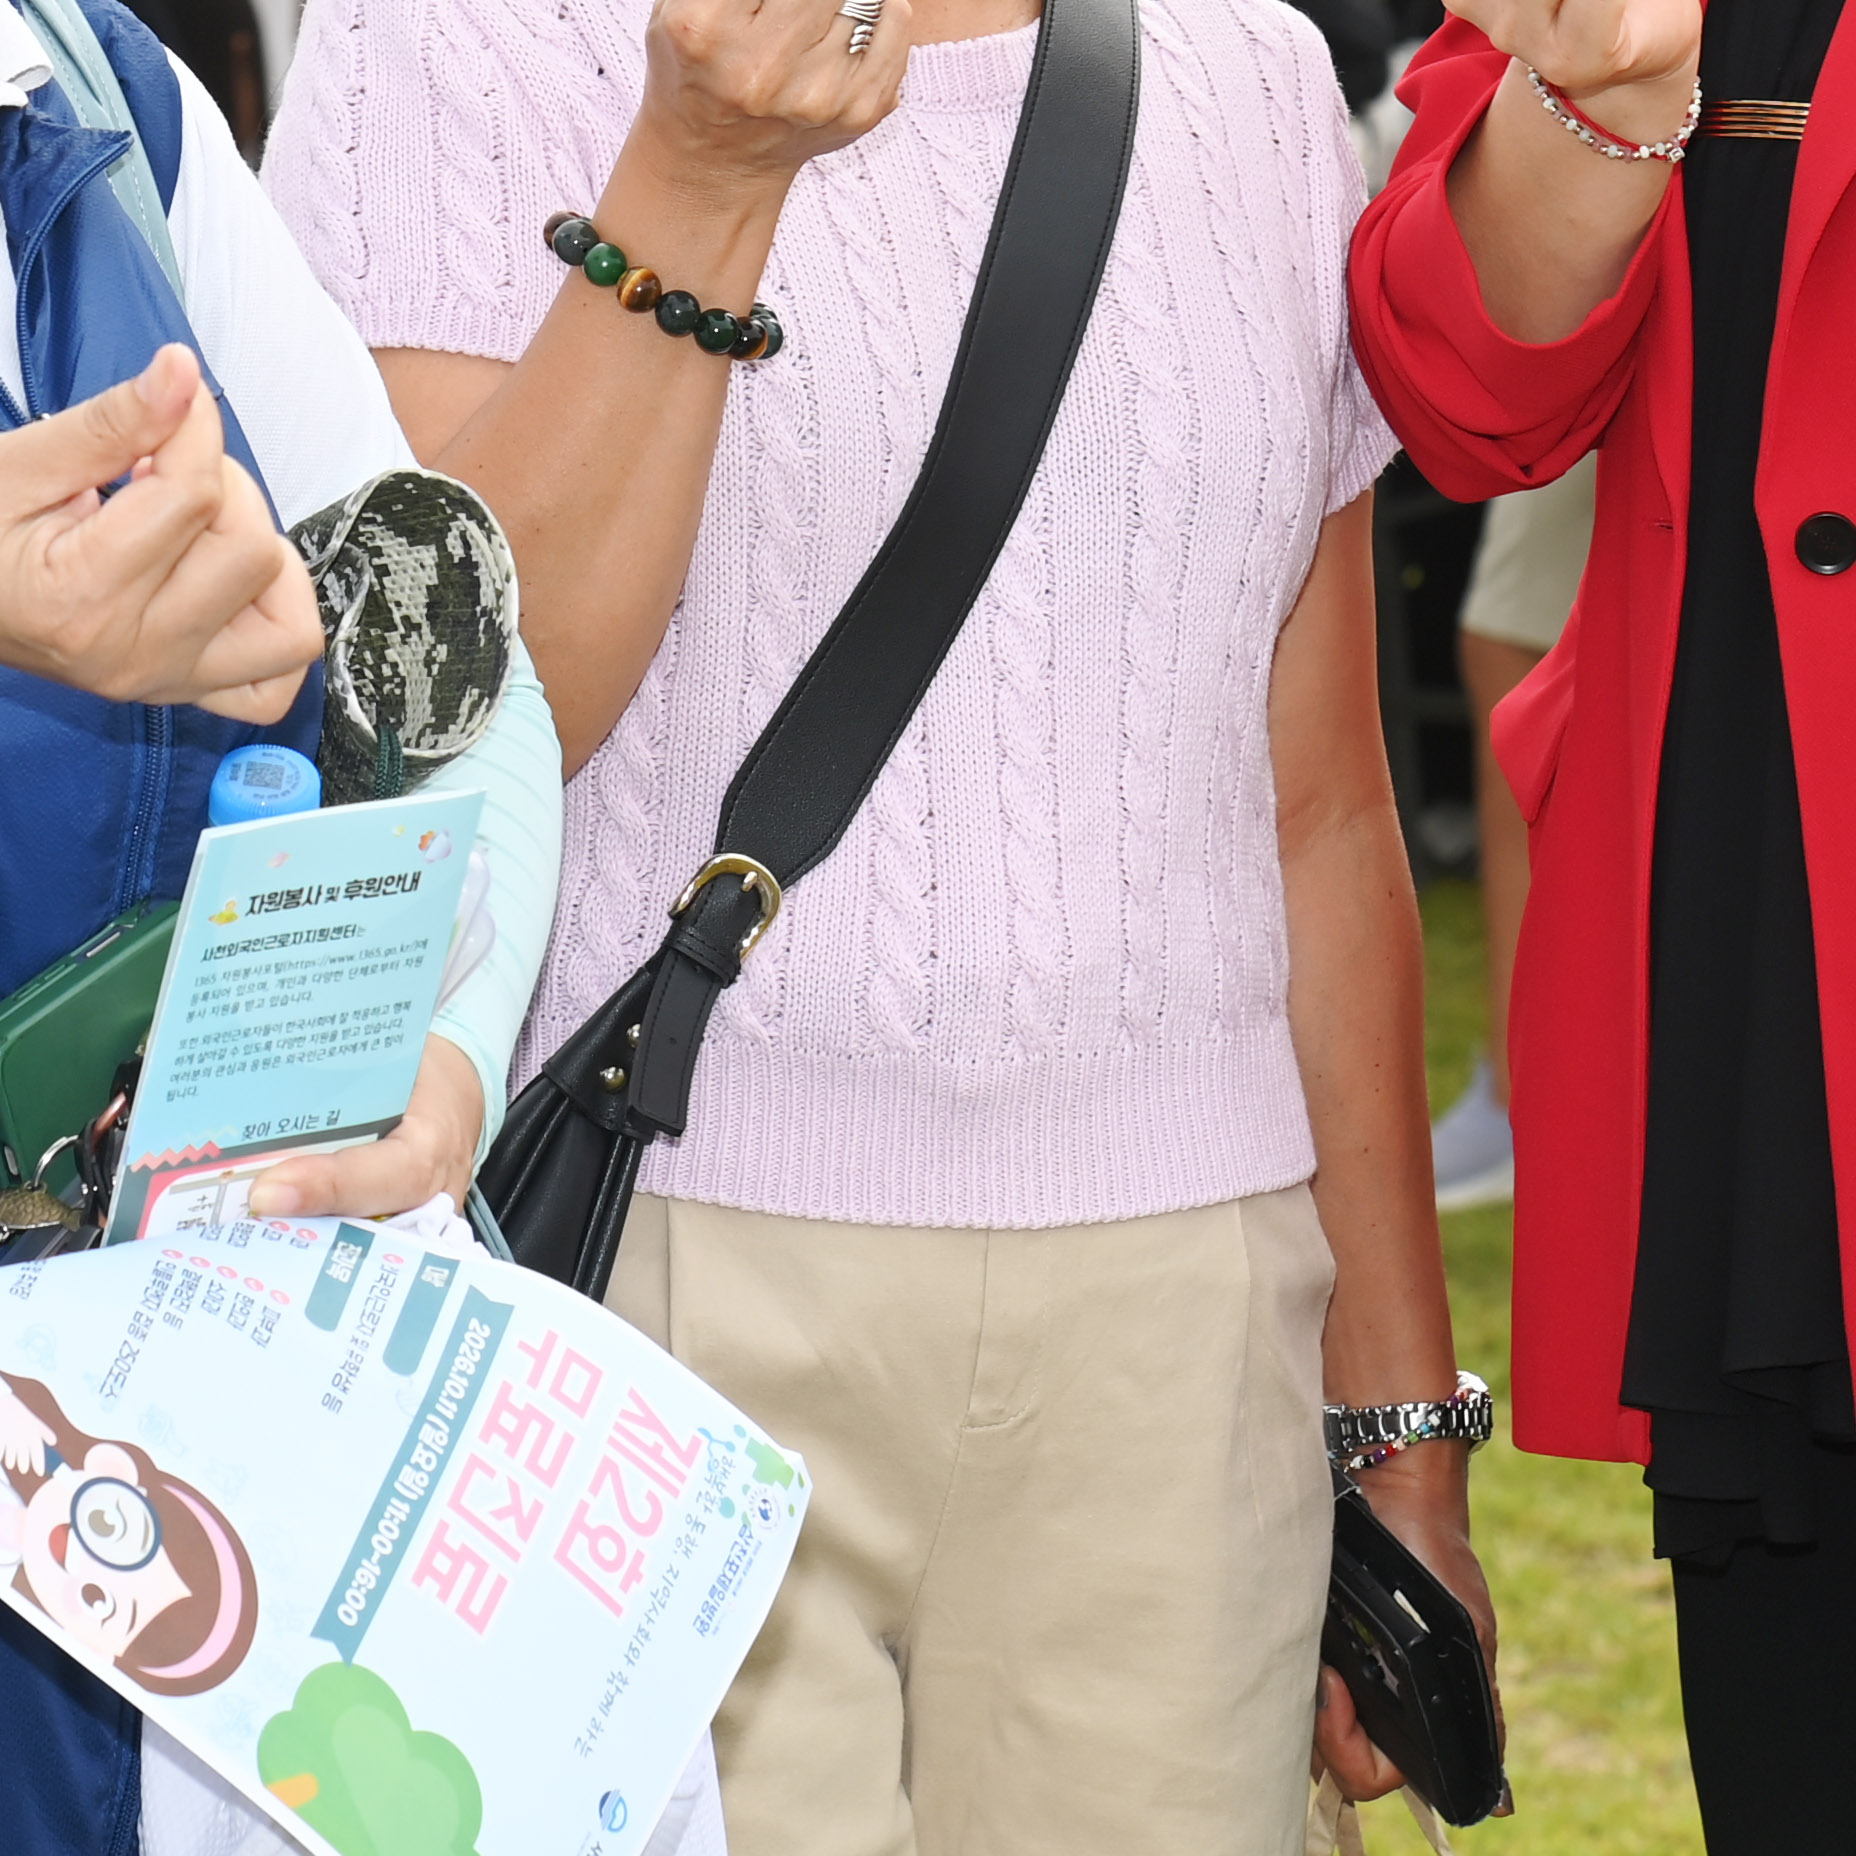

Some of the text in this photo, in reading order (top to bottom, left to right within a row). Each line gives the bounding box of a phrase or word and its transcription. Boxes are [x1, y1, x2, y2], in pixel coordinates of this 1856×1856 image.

[246, 871, 421, 915] 자원봉사 및 후원안내
[202, 924, 366, 962] 사천외국인근로자지원센터는
[190, 988, 231, 1006] 등록되어
[277, 974, 307, 989] 개인과
[311, 969, 344, 983] 다양한
[348, 960, 400, 980] 단체로부터
[404, 955, 424, 968] 자원
[194, 973, 217, 987] 1365
[178, 1036, 199, 1050] 또한
[201, 1023, 283, 1045] 외국인근로자들이
[285, 1013, 337, 1033] 한국사회에
[338, 1011, 349, 1025] 잘
[393, 1000, 412, 1014] 행복
[185, 990, 312, 1023] 봉사 지원을 받고 있습니다.
[169, 1066, 212, 1082] 여러분의
[214, 1061, 247, 1077] 관심과
[285, 1040, 368, 1064] 외국인근로자에게
[370, 1037, 380, 1051] 큰
[383, 1033, 404, 1048] 힘이
[174, 1052, 195, 1066] 하게
[197, 1047, 227, 1064] 살아갈
[229, 1045, 239, 1057] 수
[242, 1040, 273, 1056] 있도록
[275, 1035, 307, 1049] 다양한
[310, 1029, 338, 1044] 지원을
[341, 1025, 361, 1040] 받고
[242, 1108, 341, 1140] 찾아 오시는 길
[200, 1279, 224, 1314] 소아과
[226, 1291, 254, 1330] 한의과
[127, 1310, 153, 1341] 접종
[162, 1311, 183, 1330] 등
[250, 1305, 281, 1348] 피부과
[98, 1339, 140, 1398] 250도스
[435, 1318, 490, 1418] 2026.10.11
[320, 1392, 343, 1414] 등
[394, 1414, 448, 1499] (일요일)
[414, 1334, 599, 1630] 무료진료
[555, 1391, 705, 1613] 제2회
[695, 1454, 735, 1513] 행복한
[337, 1498, 409, 1625] 11:00~16:00
[692, 1524, 752, 1636] 삼천포제일병원
[623, 1564, 679, 1666] 지역사회와
[597, 1670, 628, 1717] 함께
[573, 1716, 604, 1758] 하는
